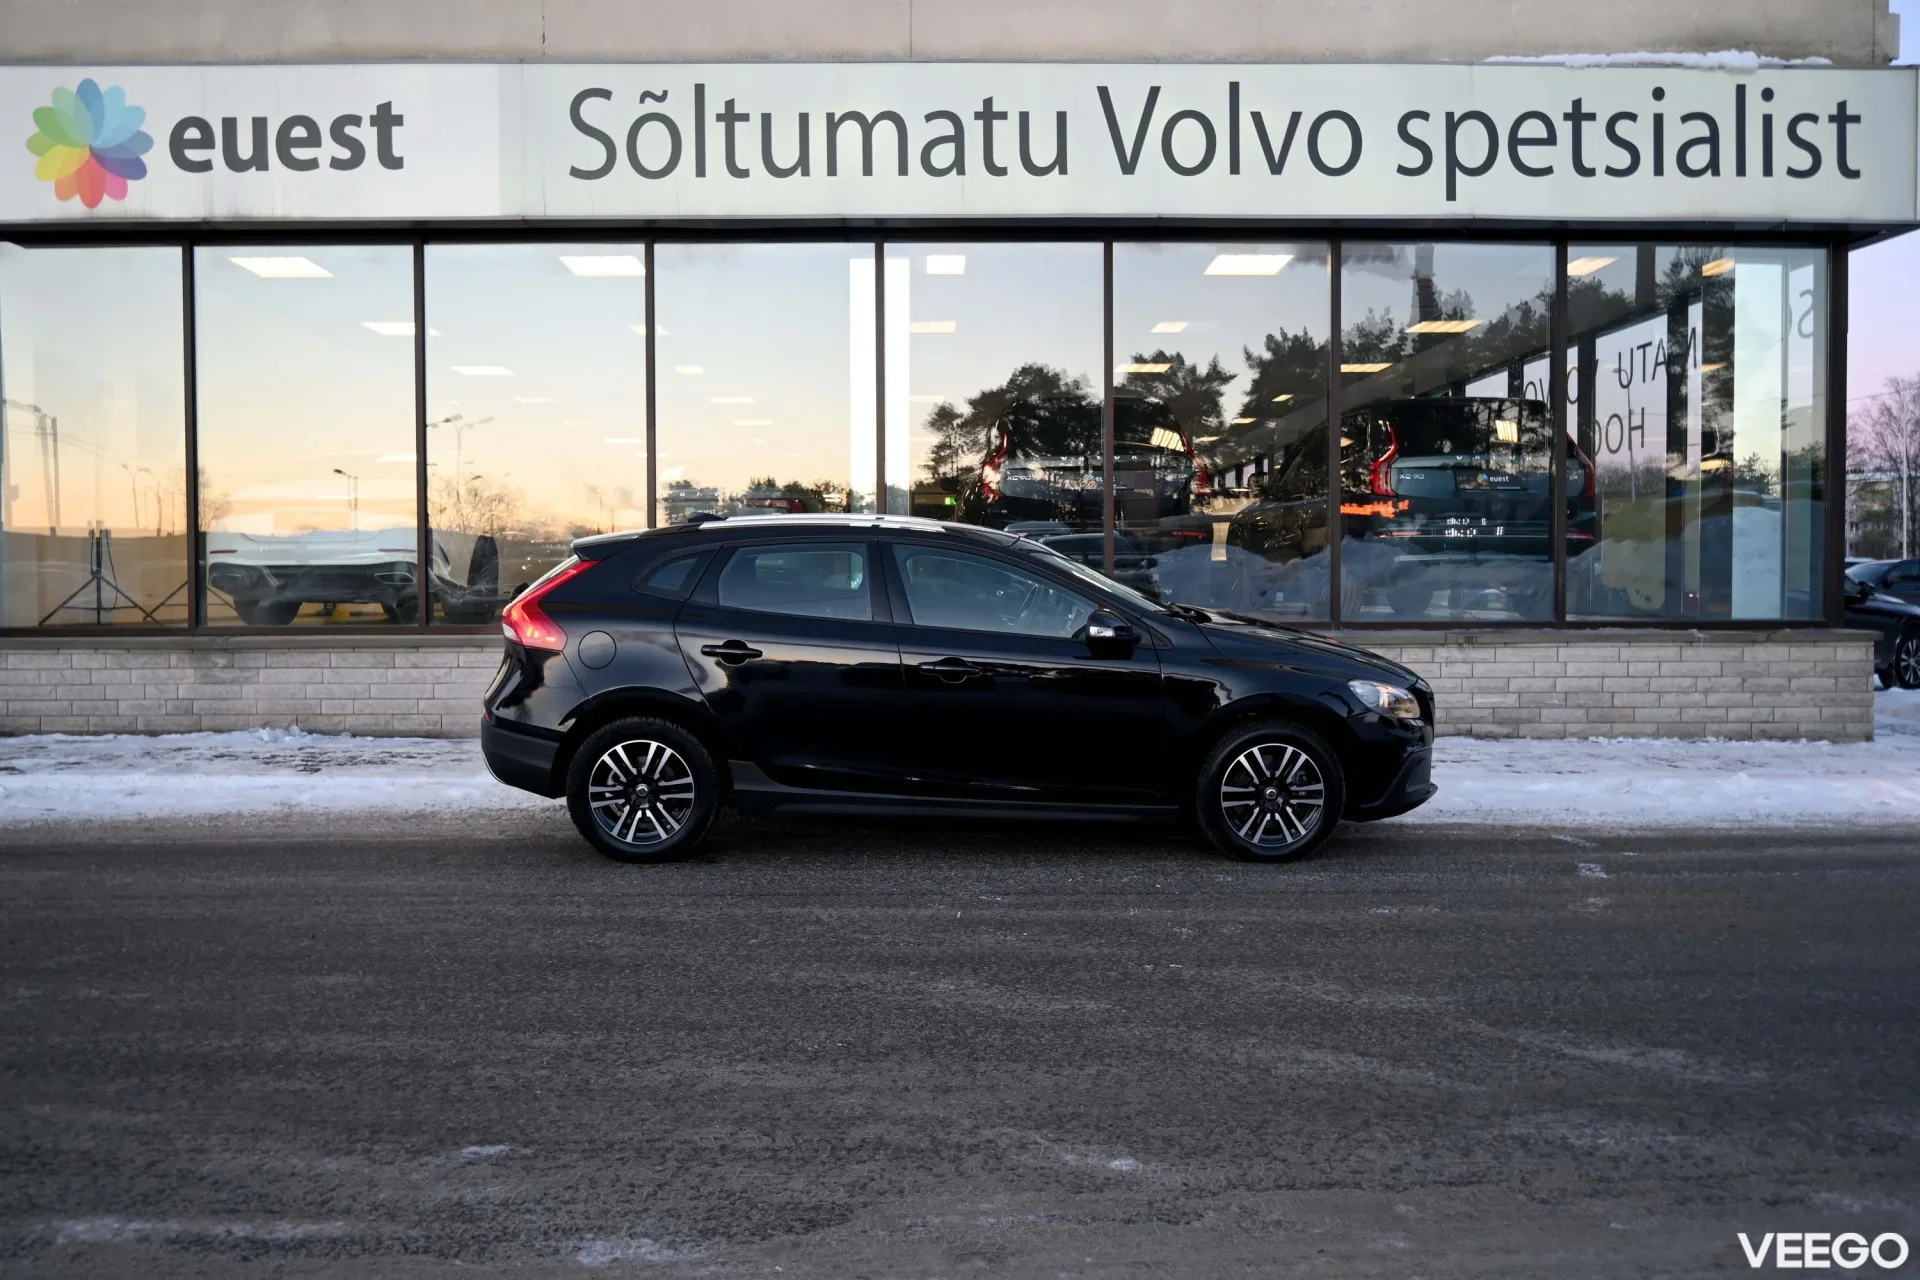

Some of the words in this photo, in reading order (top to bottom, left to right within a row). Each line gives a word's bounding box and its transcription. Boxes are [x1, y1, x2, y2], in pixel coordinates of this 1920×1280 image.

[168, 100, 404, 173] euest
[569, 83, 1067, 180] Sõltumatu
[1096, 82, 1362, 176] Volvo
[1396, 83, 1862, 201] spetsialist
[1489, 475, 1510, 483] euest
